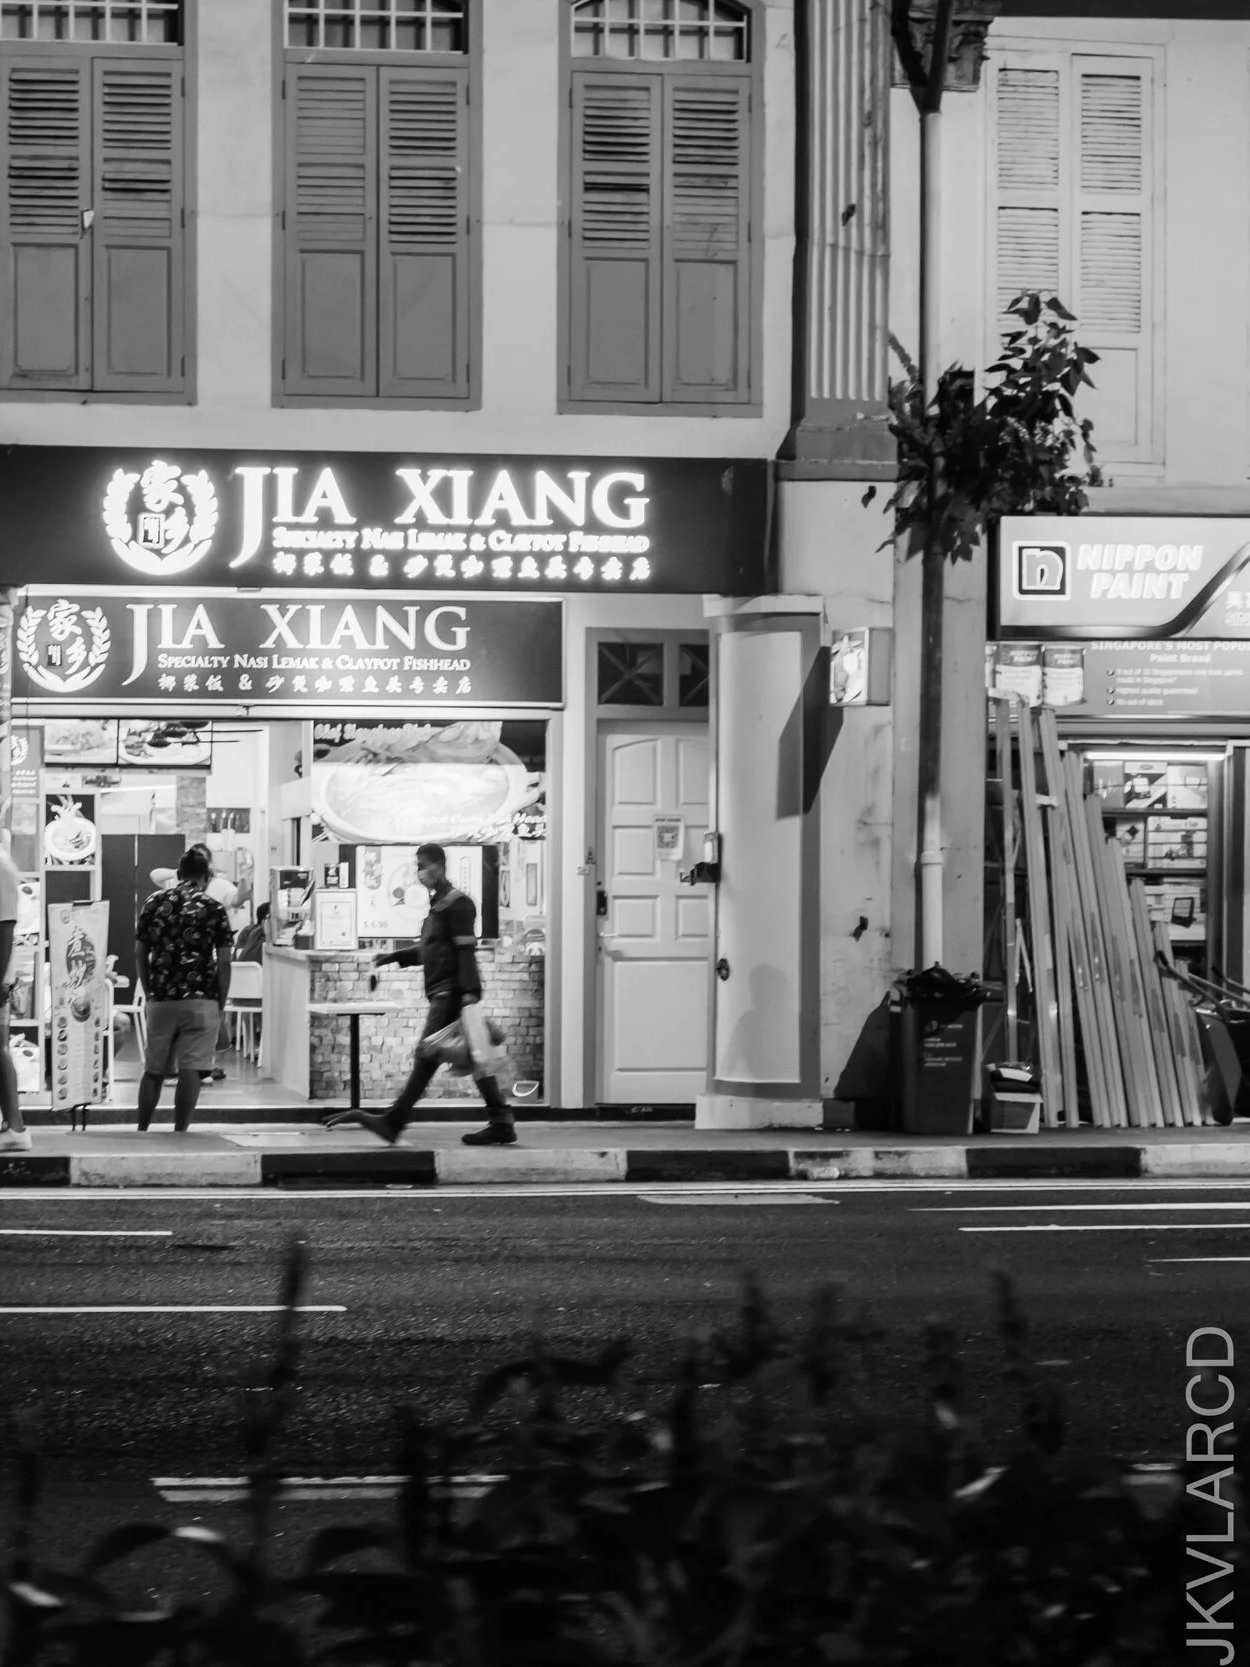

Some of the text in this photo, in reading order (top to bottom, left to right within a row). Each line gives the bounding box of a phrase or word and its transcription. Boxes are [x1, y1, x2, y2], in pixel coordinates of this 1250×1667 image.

[228, 467, 650, 569] JIA XIANG
[1076, 543, 1204, 572] NIPPON
[1090, 572, 1188, 599] PAINT
[121, 603, 471, 686] JIA XIANG
[1213, 641, 1250, 651] POPU
[157, 653, 230, 669] SPECIALTY
[233, 654, 269, 669] NASI
[272, 654, 318, 669] LEMAK
[336, 654, 400, 670] CLAYPOT
[403, 655, 471, 671] FISHHEAD
[238, 673, 253, 690] &
